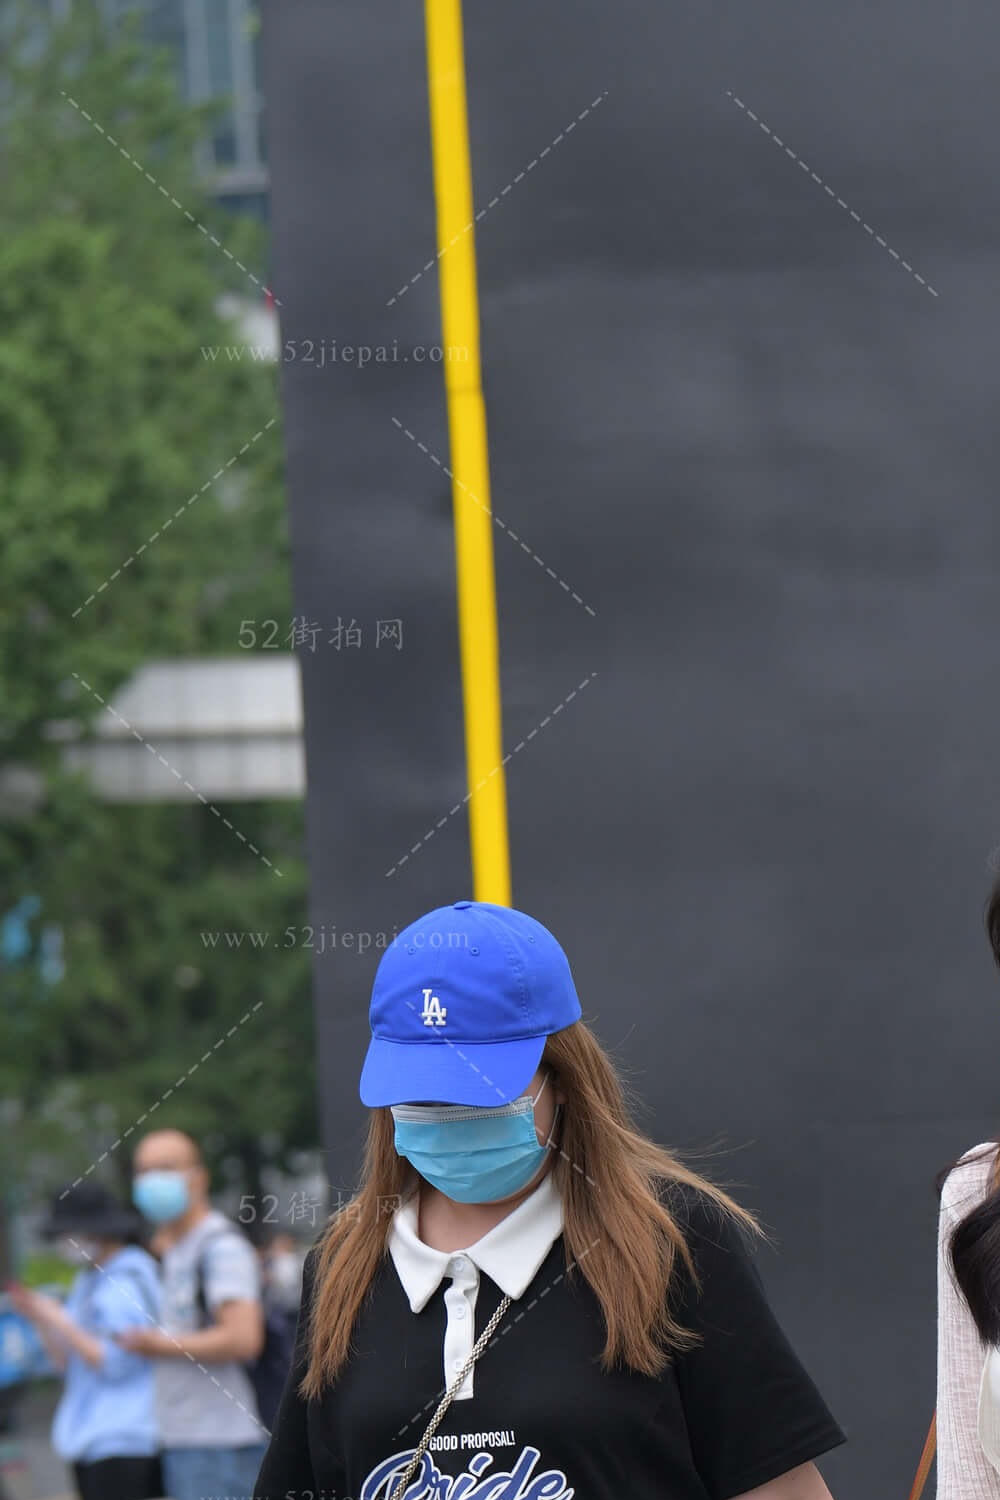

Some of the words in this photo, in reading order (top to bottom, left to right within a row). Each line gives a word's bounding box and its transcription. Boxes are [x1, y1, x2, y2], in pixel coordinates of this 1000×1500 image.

[421, 988, 447, 1026] LA
[429, 1434, 458, 1451] GOOD
[460, 1430, 516, 1450] PROPOSAL!
